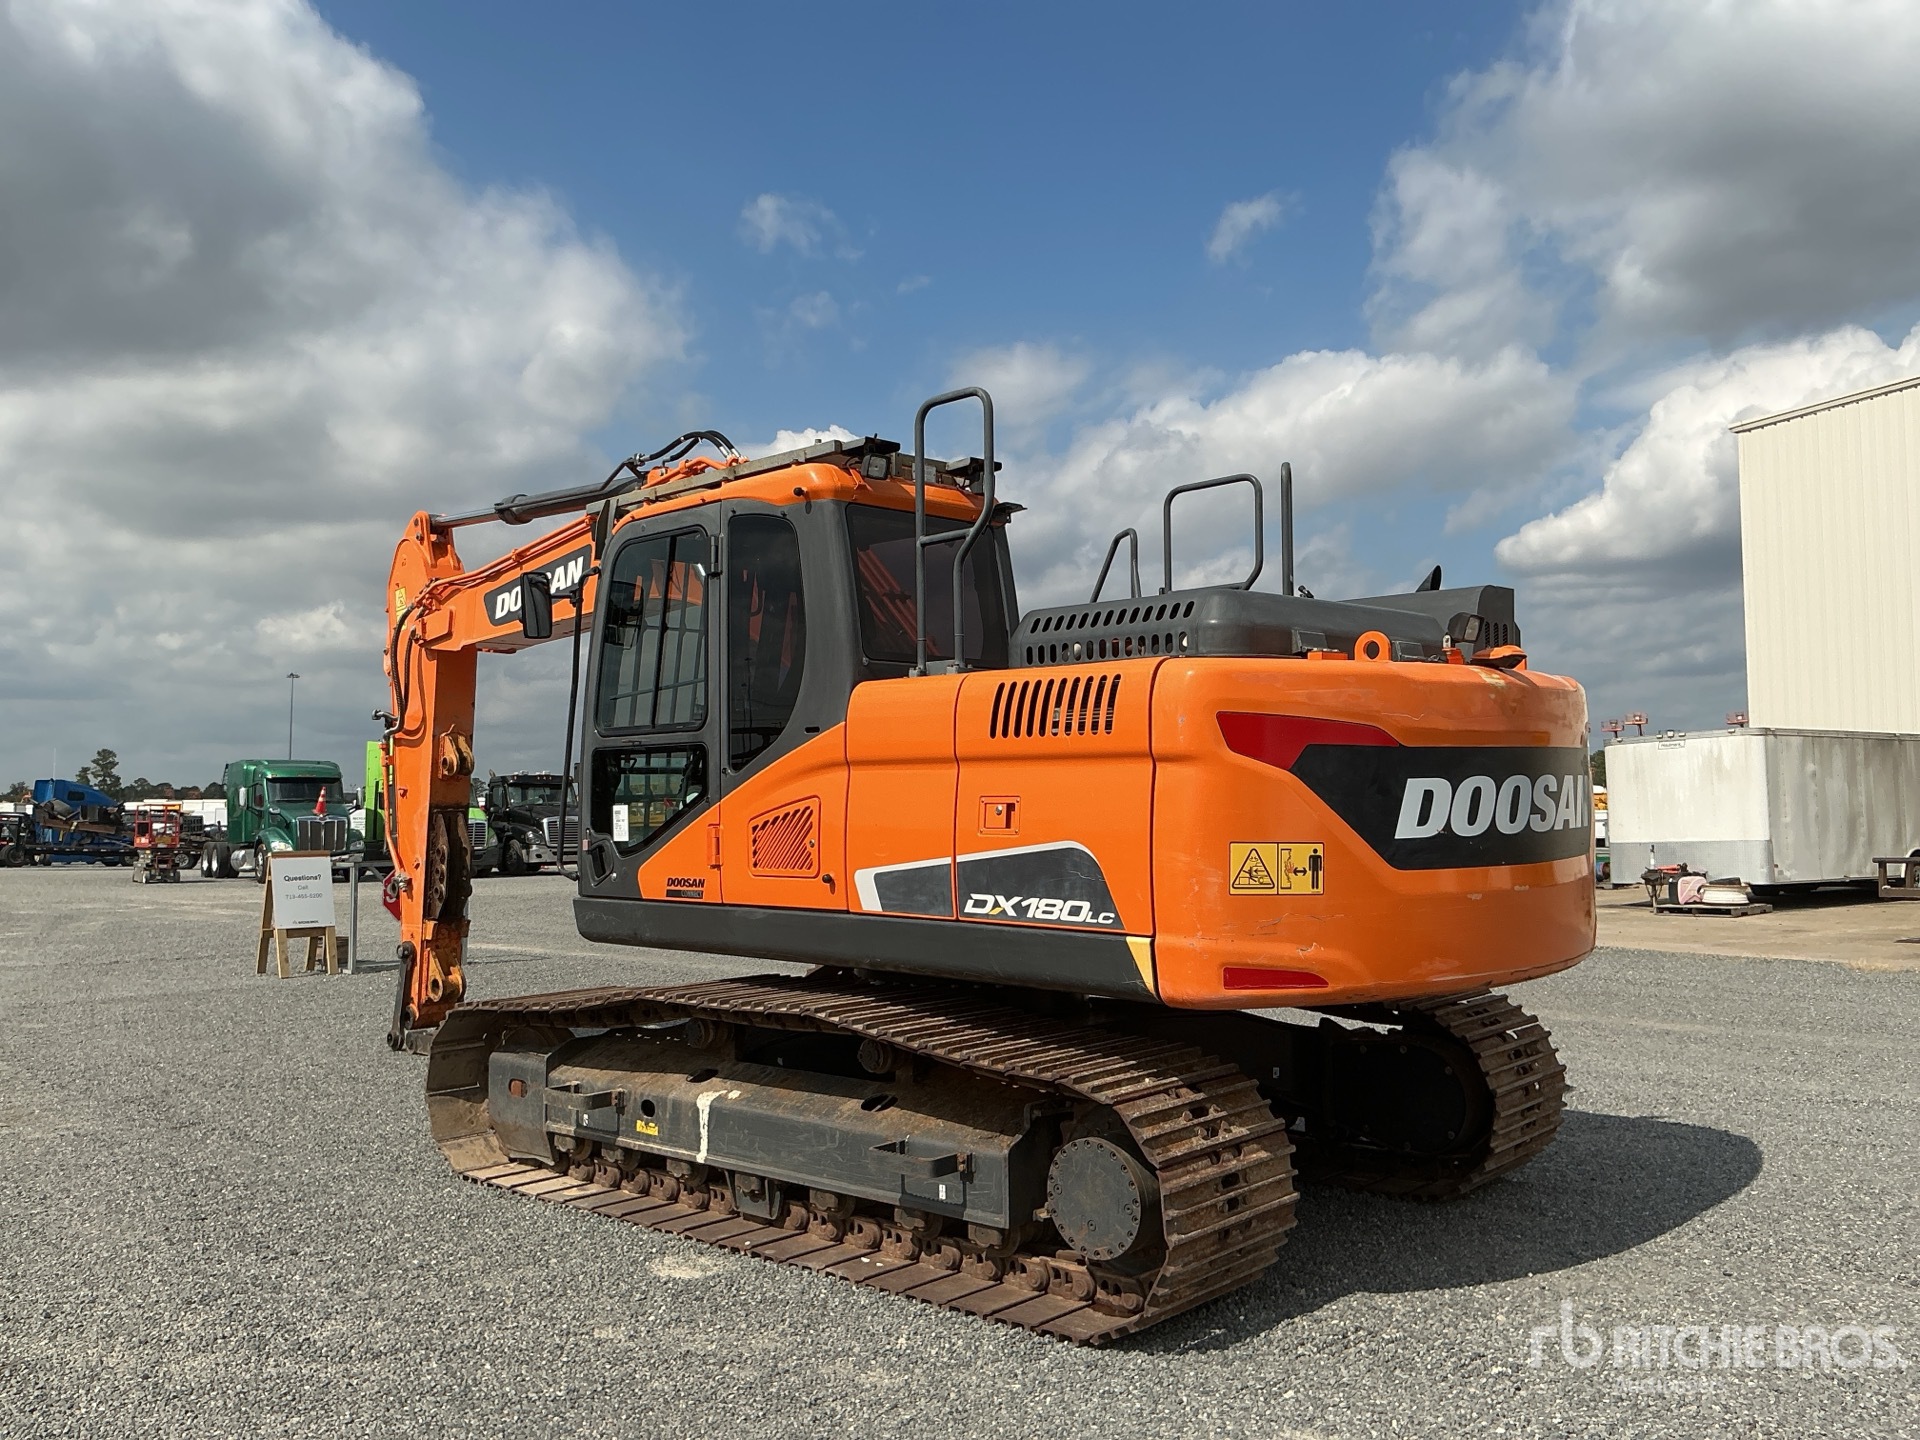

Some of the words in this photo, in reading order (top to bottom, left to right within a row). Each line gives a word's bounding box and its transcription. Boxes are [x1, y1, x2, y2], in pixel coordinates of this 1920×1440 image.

[495, 556, 584, 619] DOAN
[1394, 774, 1589, 840] DOOSAN
[283, 874, 321, 882] Questions?
[667, 877, 706, 888] DOOSAN
